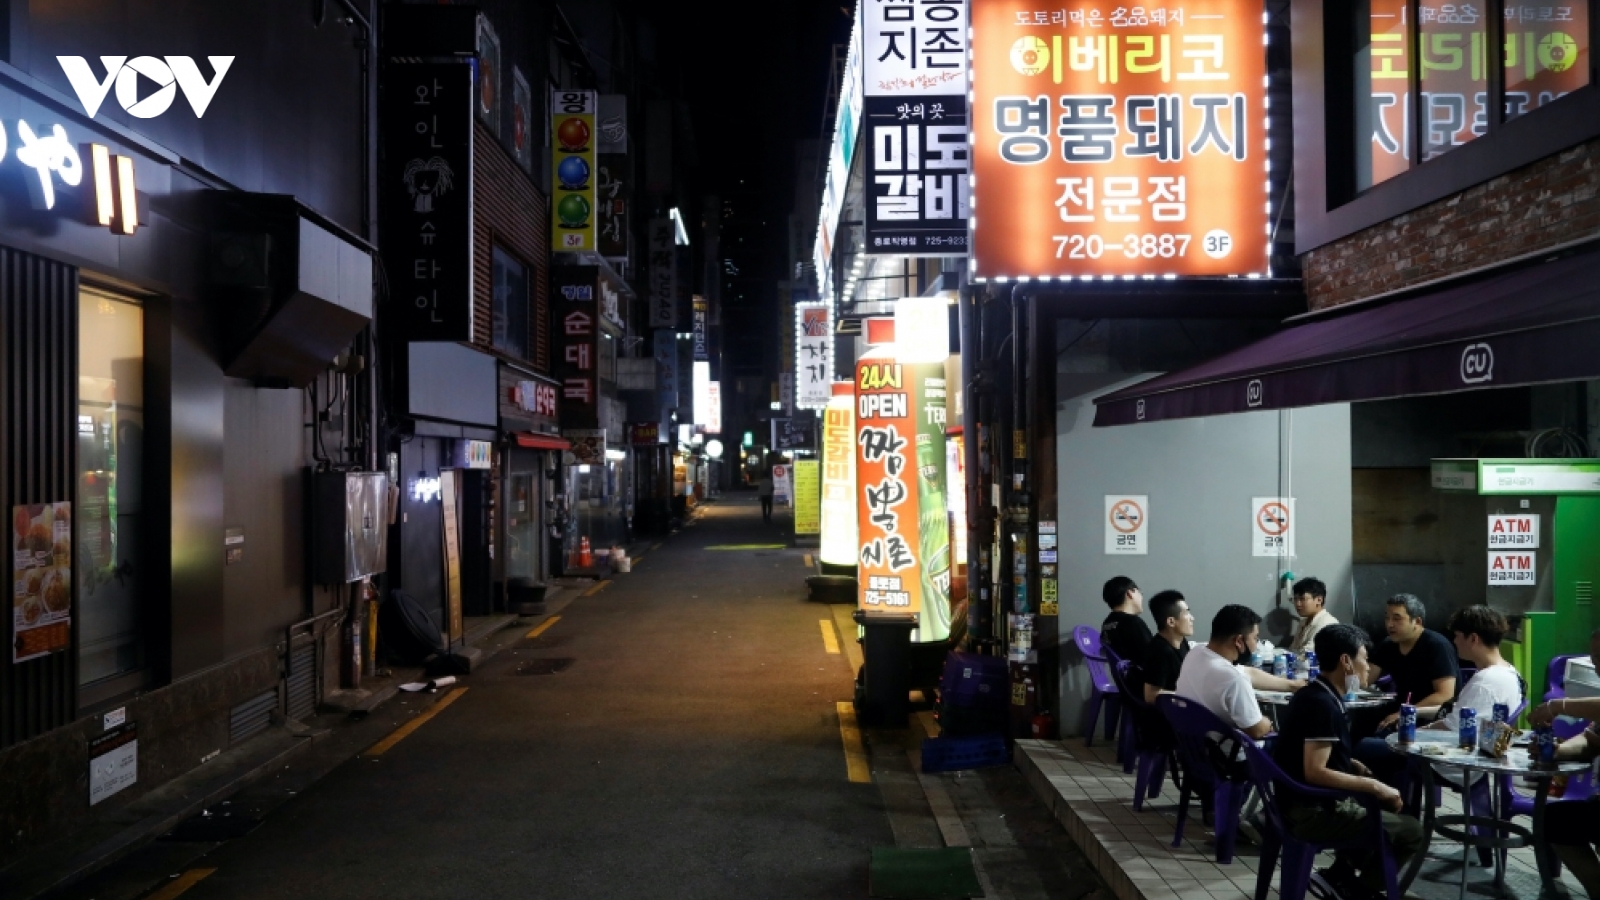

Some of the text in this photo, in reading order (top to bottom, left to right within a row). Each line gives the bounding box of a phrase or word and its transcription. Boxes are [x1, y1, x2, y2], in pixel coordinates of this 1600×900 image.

[1014, 8, 1104, 27] 도토리먹은
[877, 26, 965, 69] 지존
[1010, 34, 1230, 84] 이베리코
[559, 92, 589, 114] 왕
[896, 102, 924, 121] 맛의
[993, 93, 1246, 163] 명품돼지
[873, 124, 968, 171] 미도
[875, 173, 968, 221] 갈비
[1054, 176, 1187, 222] 전문점
[1052, 234, 1230, 260] 720-3887 3F
[564, 310, 592, 402] 순대국
[860, 364, 902, 390] 24시
[860, 394, 907, 418] OPEN
[827, 409, 851, 480] 미도갈비
[860, 427, 905, 531] 짬뽕
[1492, 518, 1531, 533] ATM
[1116, 534, 1136, 546] 금연
[1490, 535, 1534, 544] 현금지급기
[863, 537, 913, 570] 지존
[1492, 555, 1531, 570] ATM
[1490, 571, 1534, 581] 현금지급기
